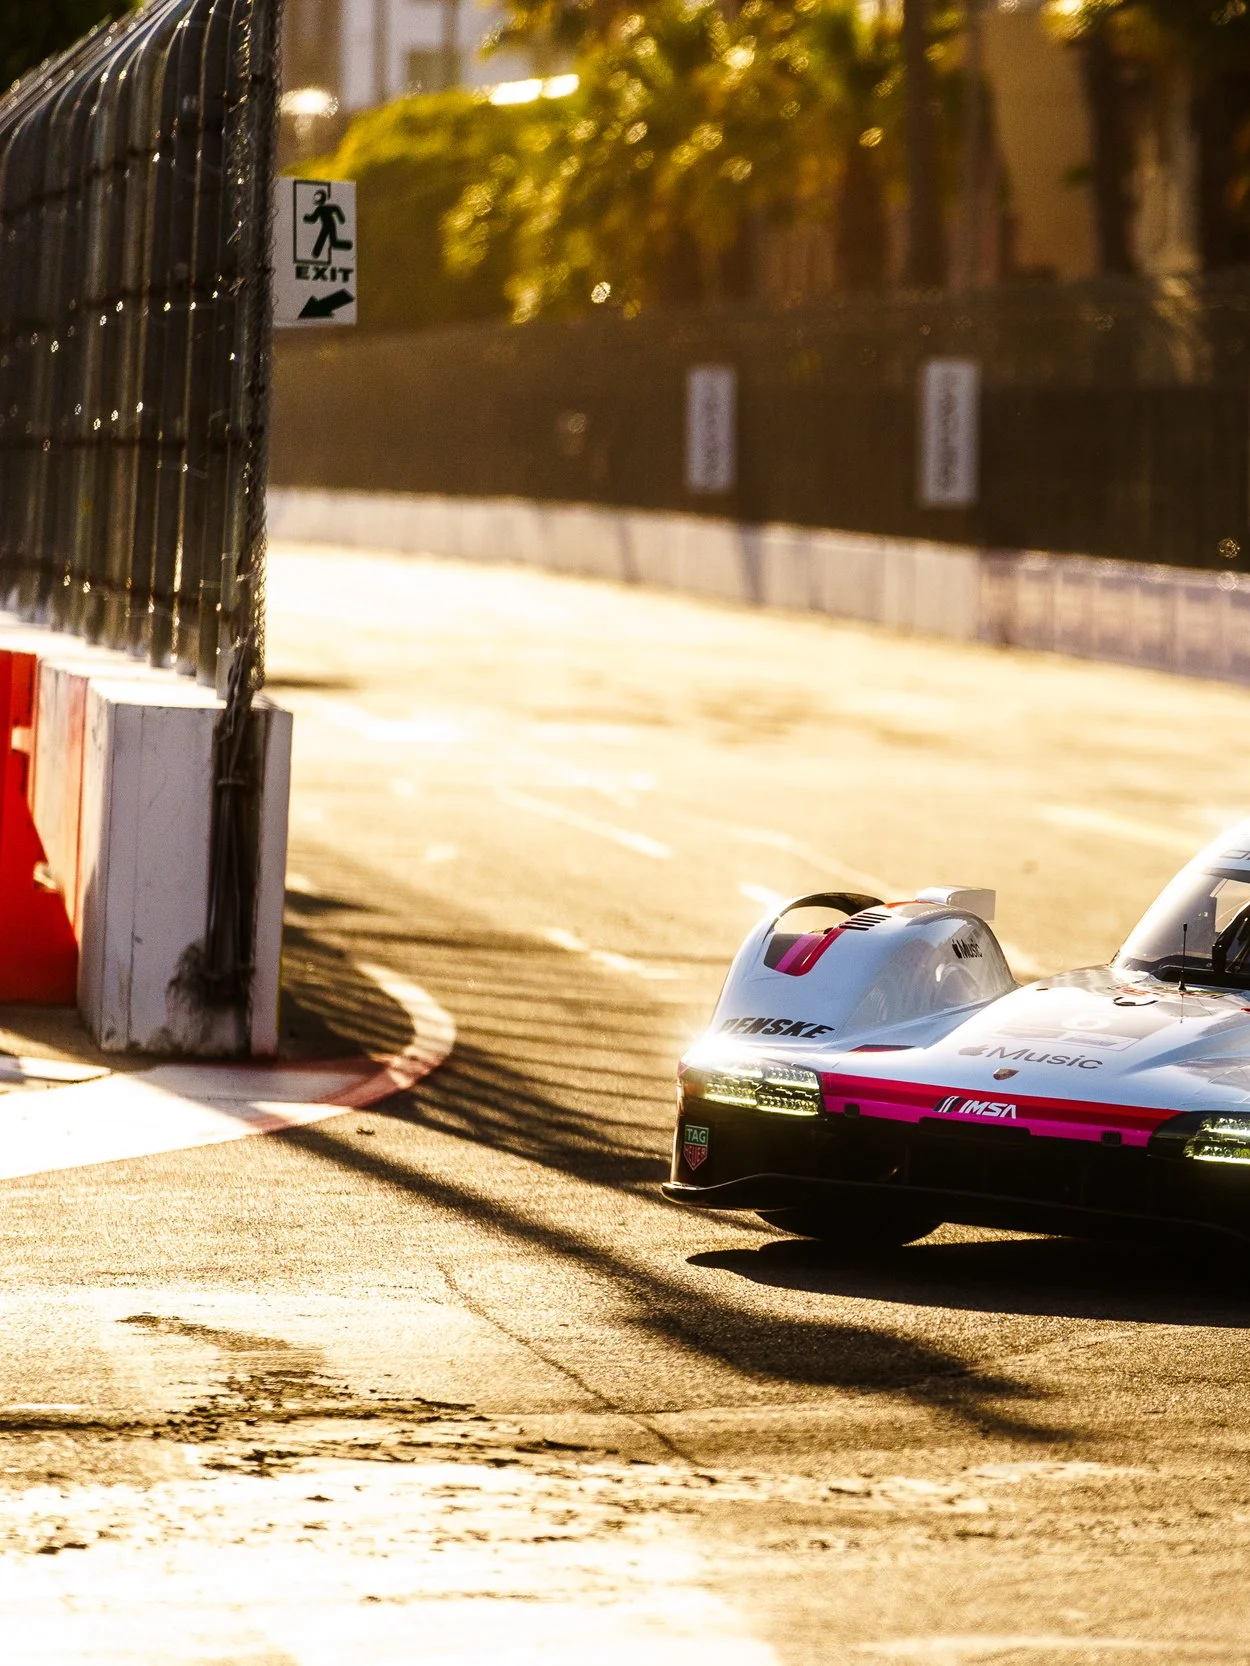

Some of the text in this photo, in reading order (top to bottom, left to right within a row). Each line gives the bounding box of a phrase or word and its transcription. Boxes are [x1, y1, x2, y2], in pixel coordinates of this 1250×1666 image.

[295, 265, 353, 283] EXIT
[956, 938, 983, 959] Music
[719, 1017, 835, 1039] PENSKE
[985, 1046, 1103, 1069] Music
[959, 1099, 1017, 1119] IMSA
[687, 1128, 706, 1143] TAG
